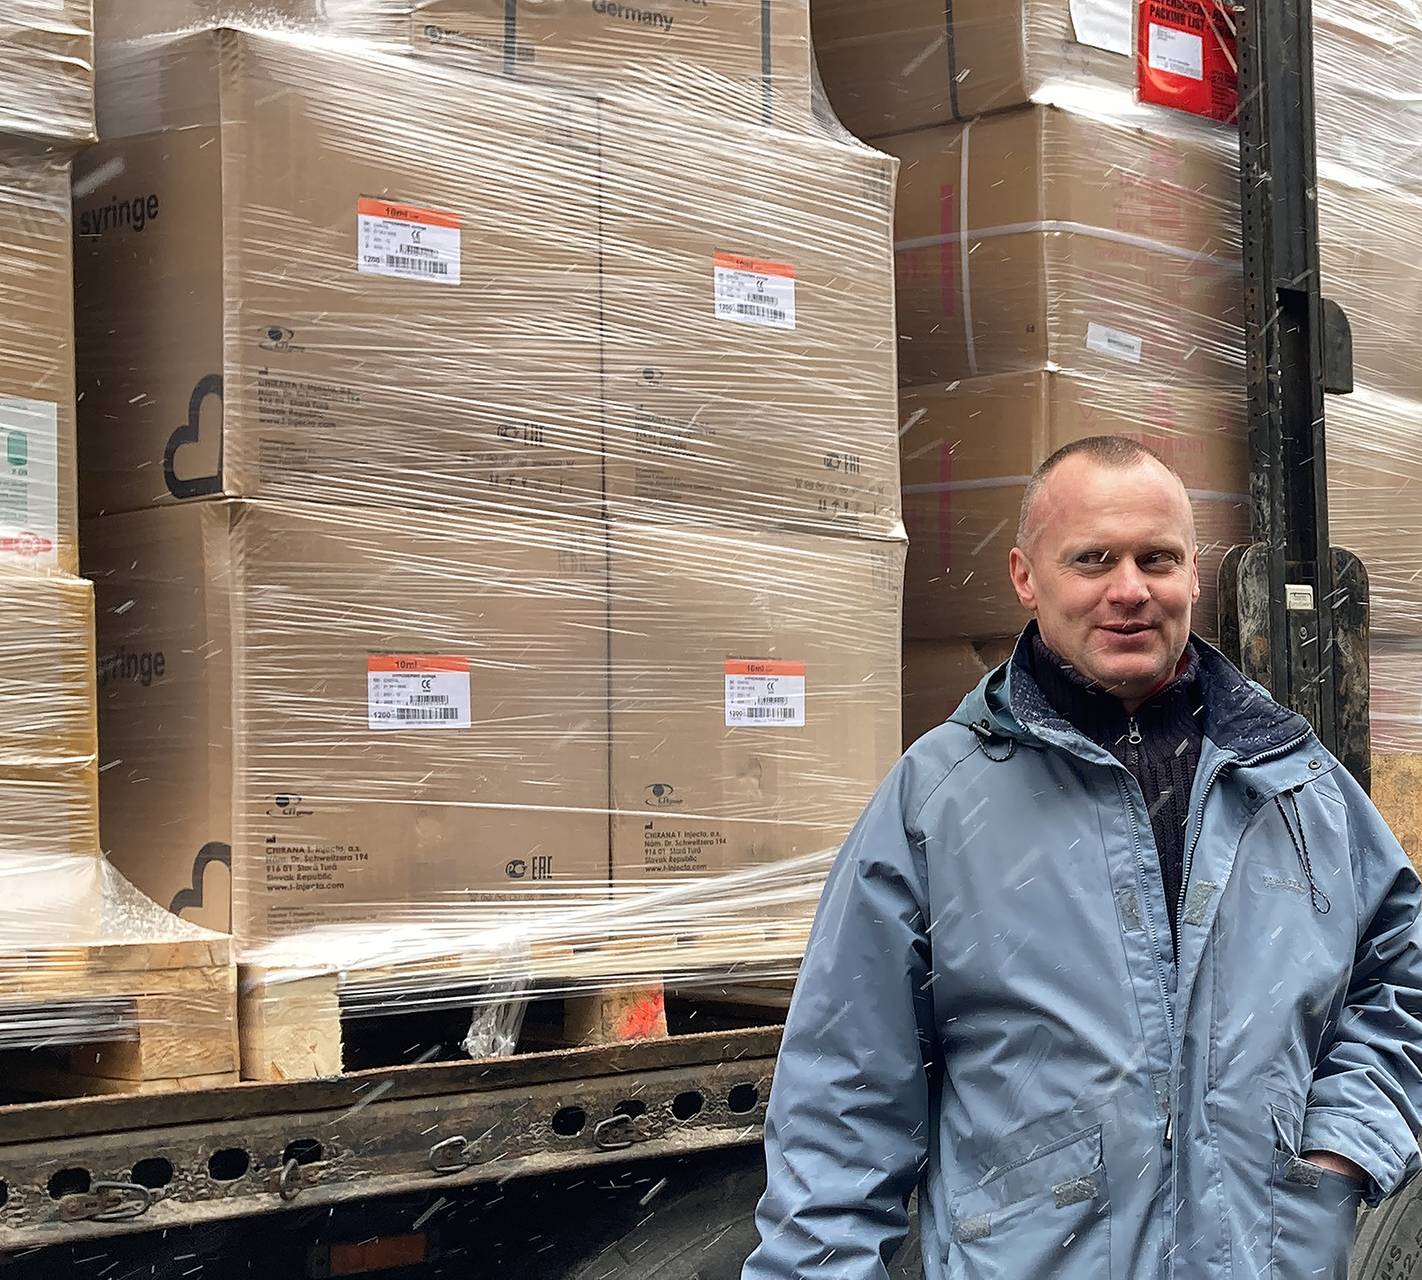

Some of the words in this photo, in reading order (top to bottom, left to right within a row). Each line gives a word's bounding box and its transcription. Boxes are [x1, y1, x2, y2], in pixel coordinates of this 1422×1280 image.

[1150, 4, 1186, 26] PACKING
[1188, 15, 1204, 31] LIST
[80, 194, 160, 242] syringe
[395, 660, 417, 669] 10ml
[373, 711, 391, 719] 1200
[266, 846, 305, 855] CHIRANA
[355, 852, 369, 861] 194
[296, 873, 332, 882] Republic
